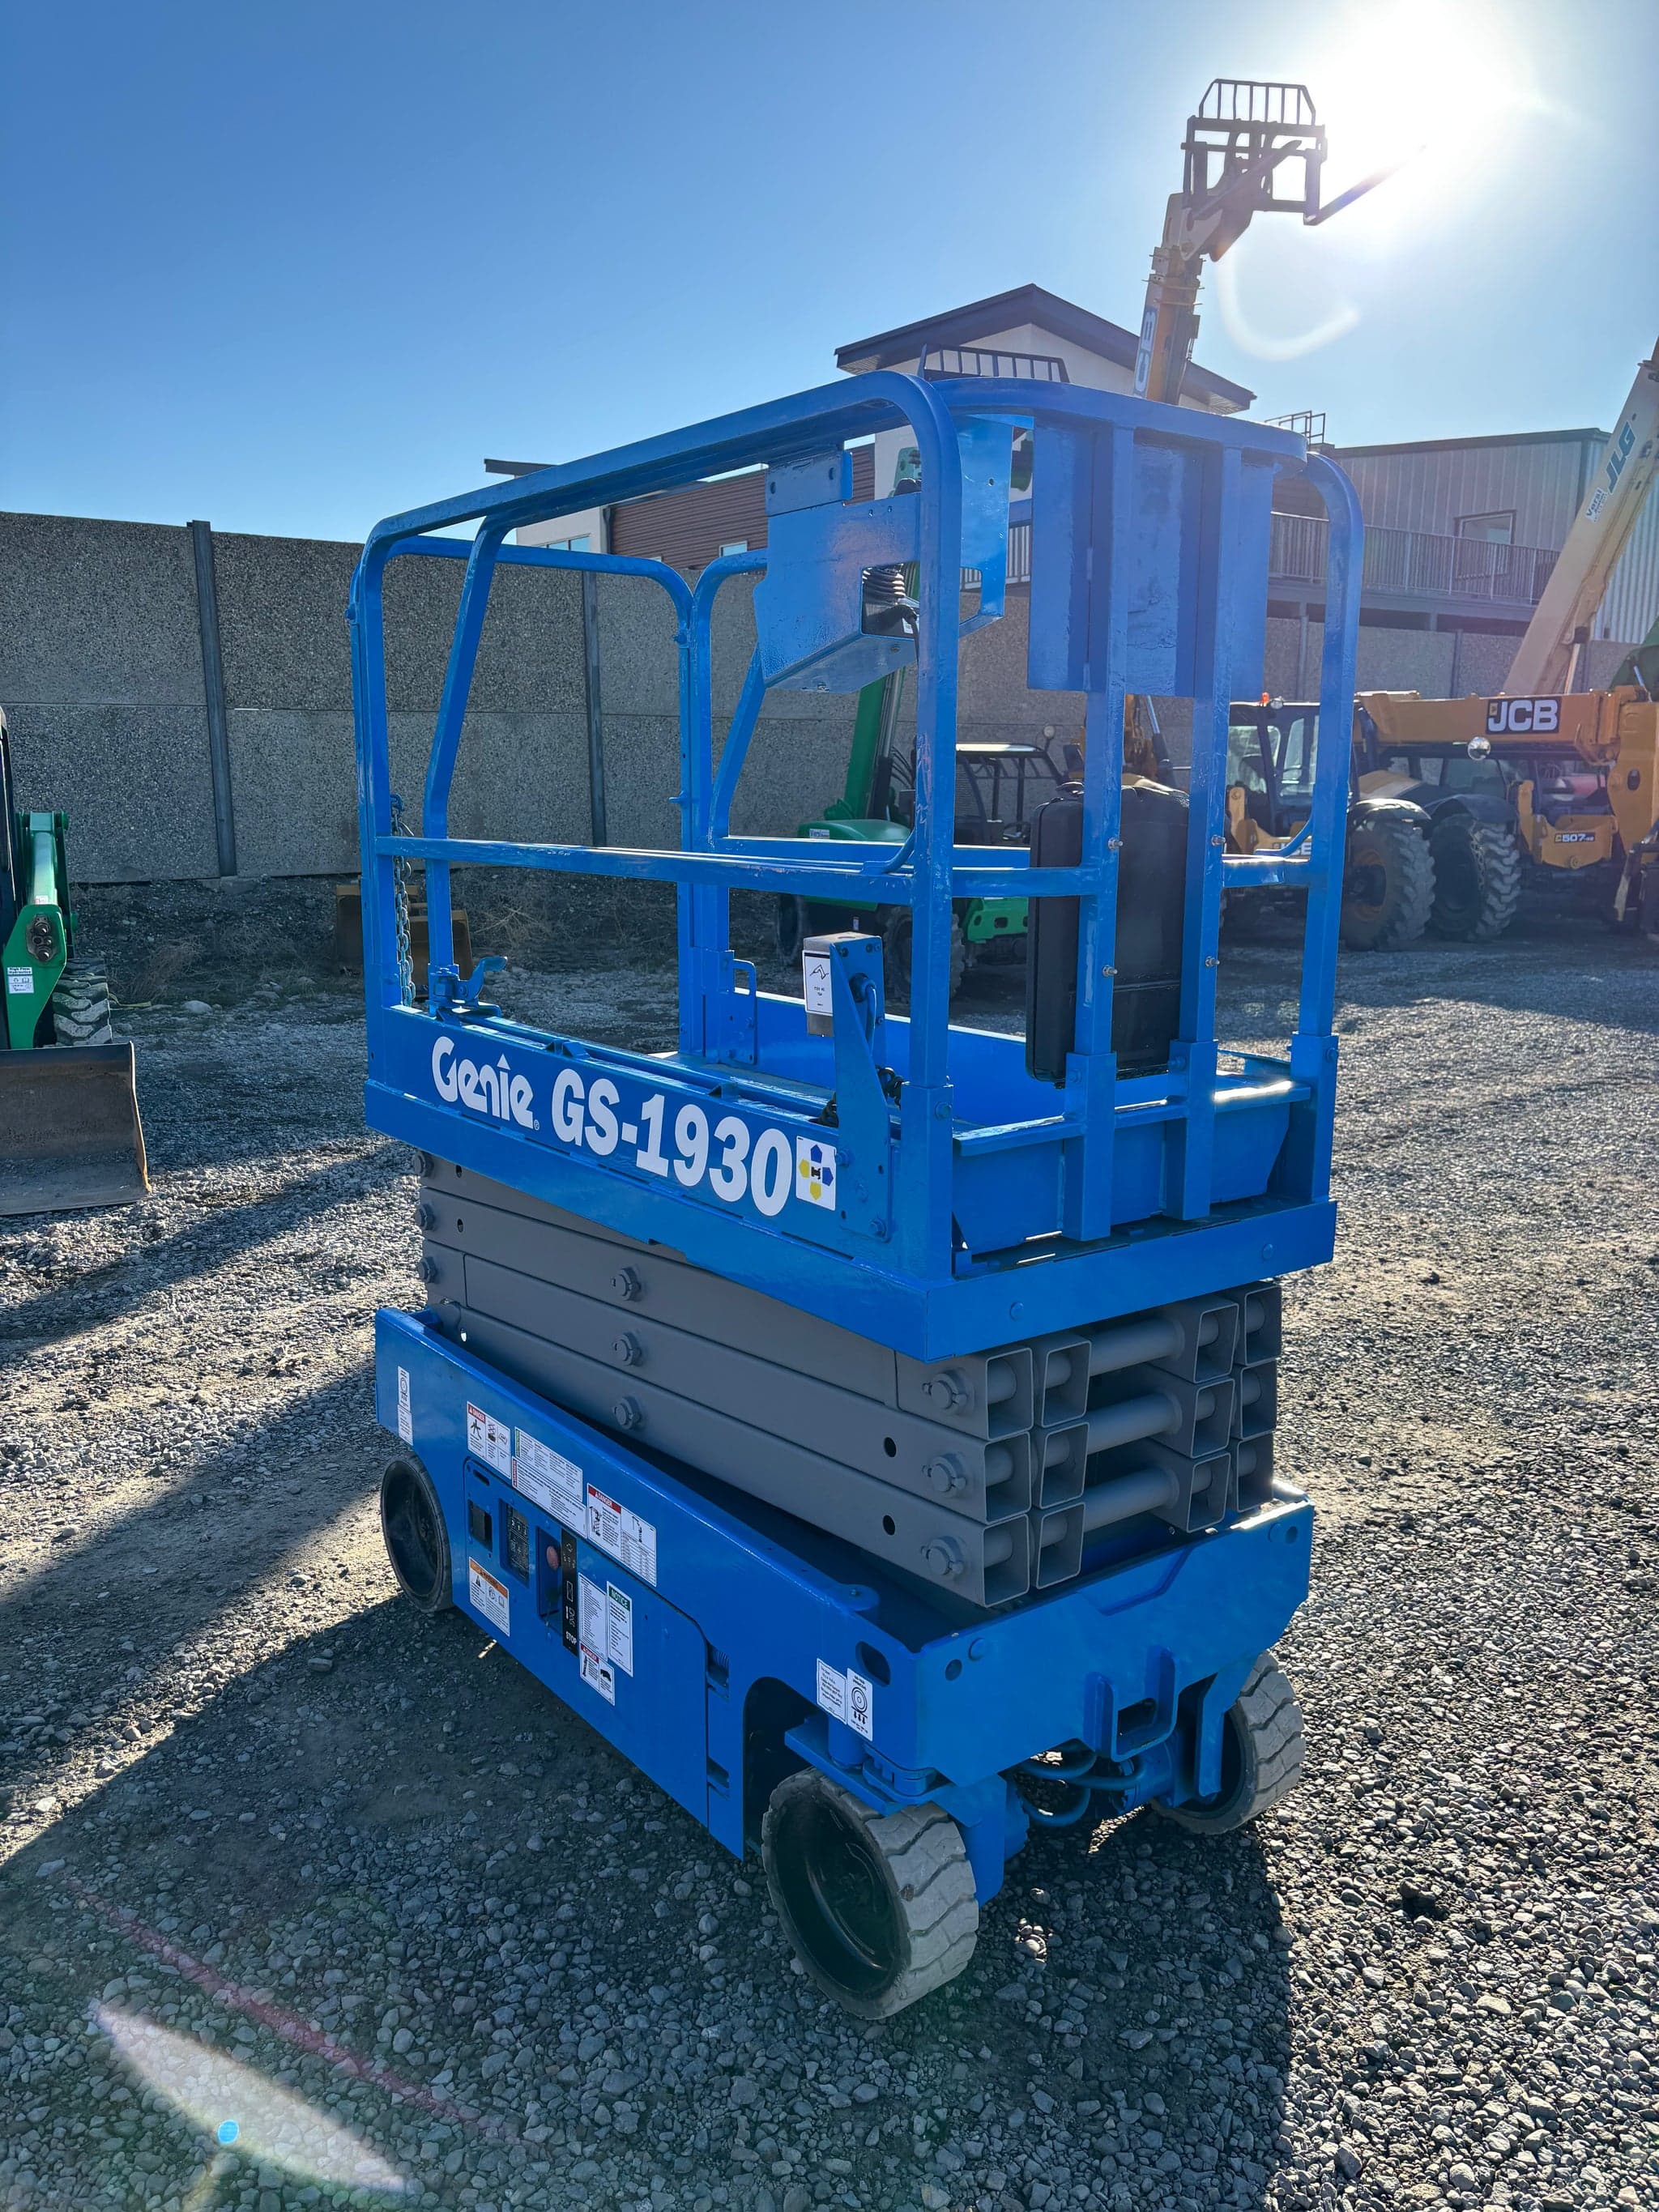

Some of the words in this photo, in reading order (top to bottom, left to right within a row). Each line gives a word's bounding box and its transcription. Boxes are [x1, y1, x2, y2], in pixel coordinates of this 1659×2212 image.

[1135, 311, 1157, 392] CB
[1606, 421, 1636, 494] JLG
[1488, 699, 1559, 732] JCB
[432, 1036, 535, 1130] Genie
[552, 1068, 793, 1217] GS-1930
[610, 1588, 629, 1609] NOTICE
[565, 1631, 578, 1645] STOP
